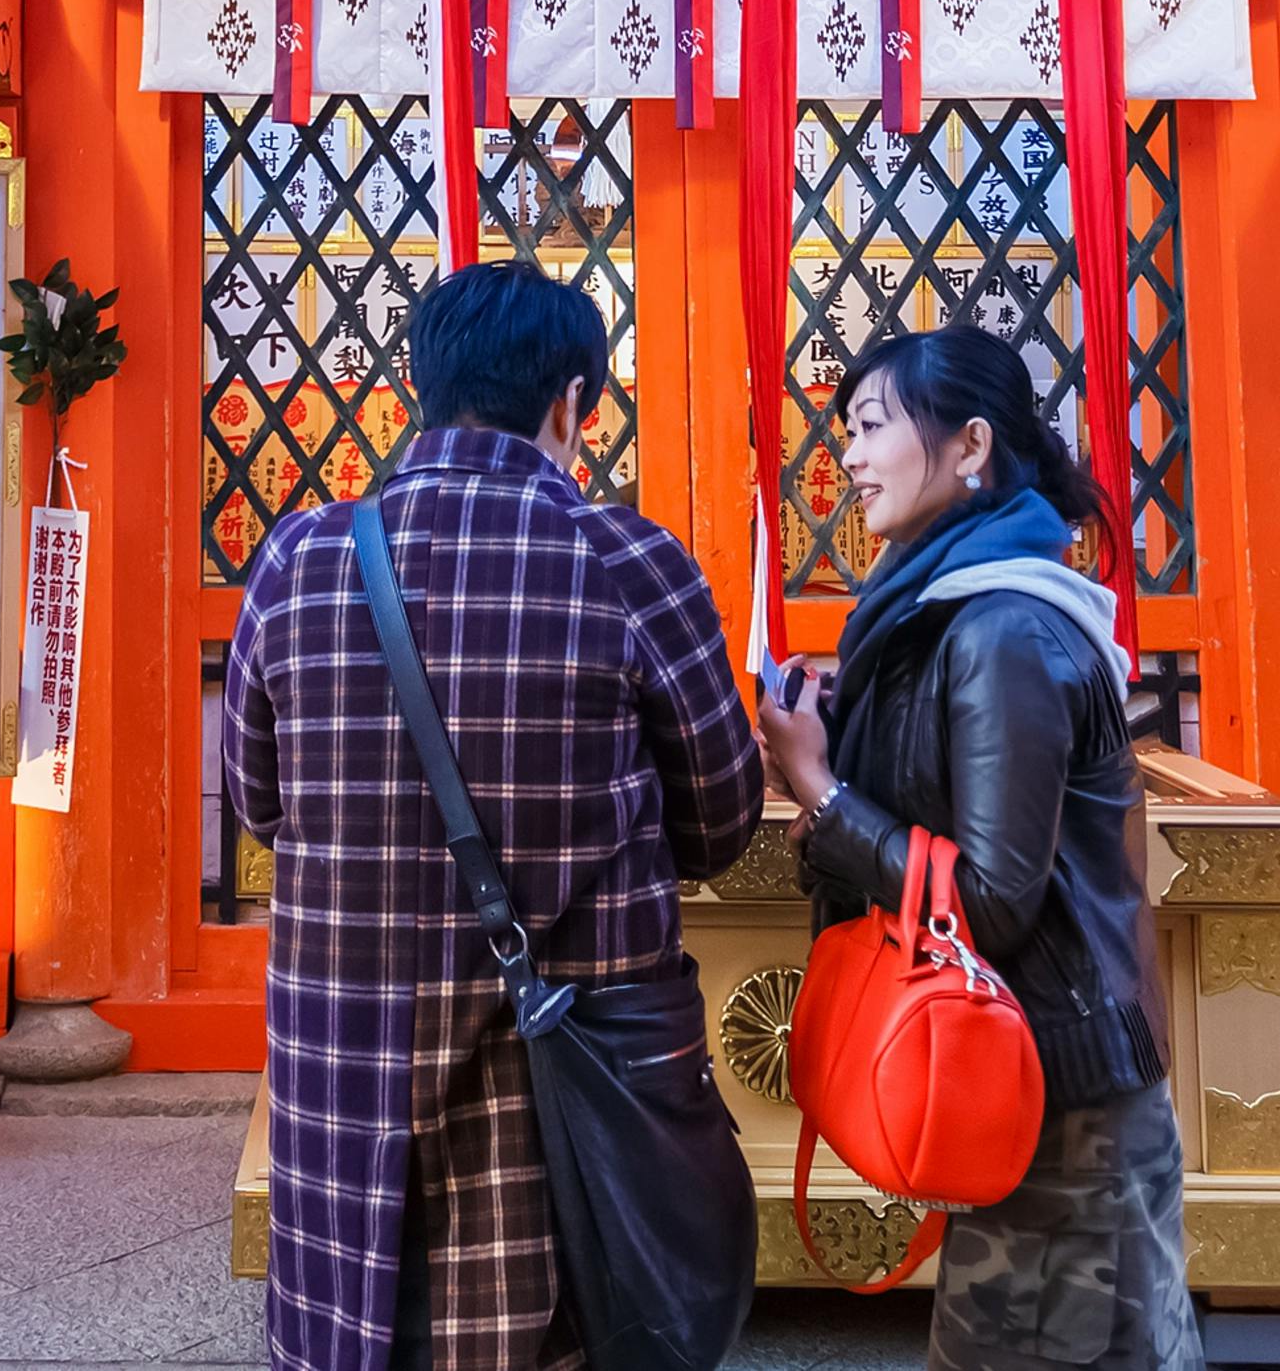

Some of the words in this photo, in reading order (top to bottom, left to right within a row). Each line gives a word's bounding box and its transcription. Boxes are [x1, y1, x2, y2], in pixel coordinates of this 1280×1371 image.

[798, 131, 816, 183] NH
[31, 525, 49, 627] 谢谢合作
